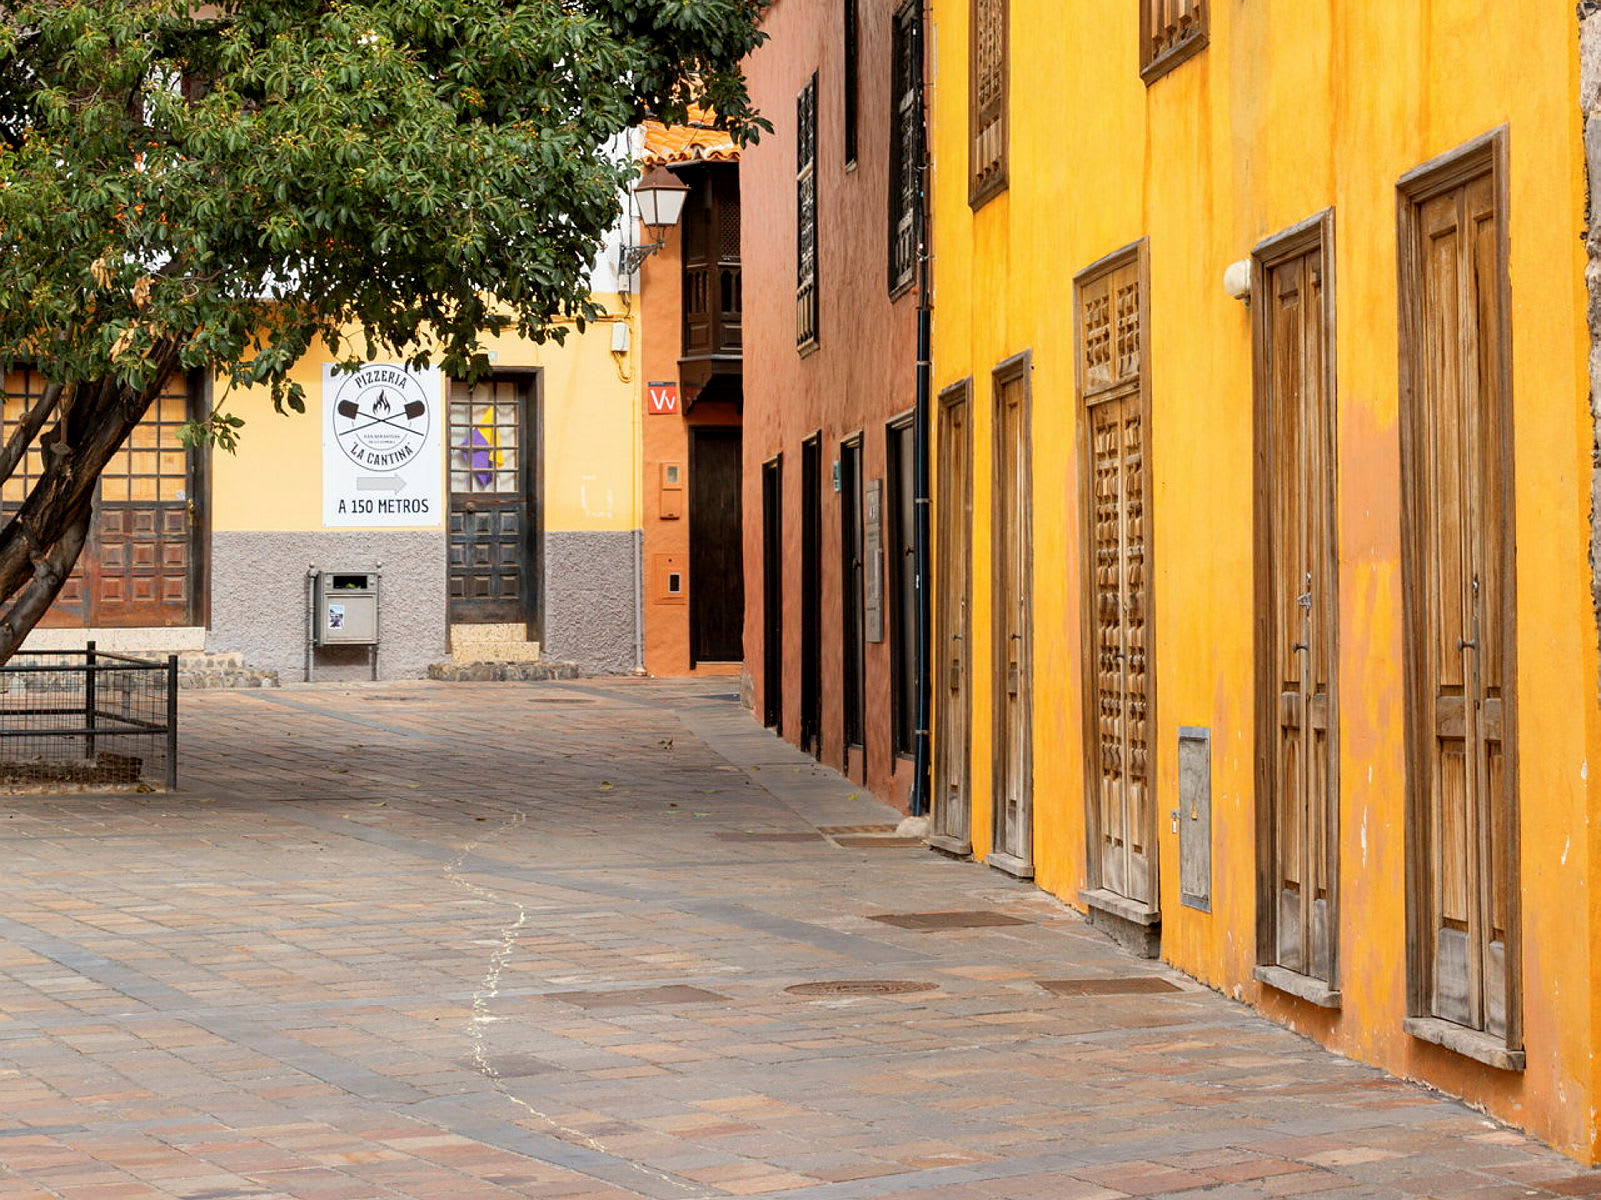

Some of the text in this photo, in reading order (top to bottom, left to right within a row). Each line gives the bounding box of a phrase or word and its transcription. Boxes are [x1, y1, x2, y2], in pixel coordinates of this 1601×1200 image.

[354, 370, 408, 389] PIZZERIA
[338, 498, 430, 514] A 150 METROS
